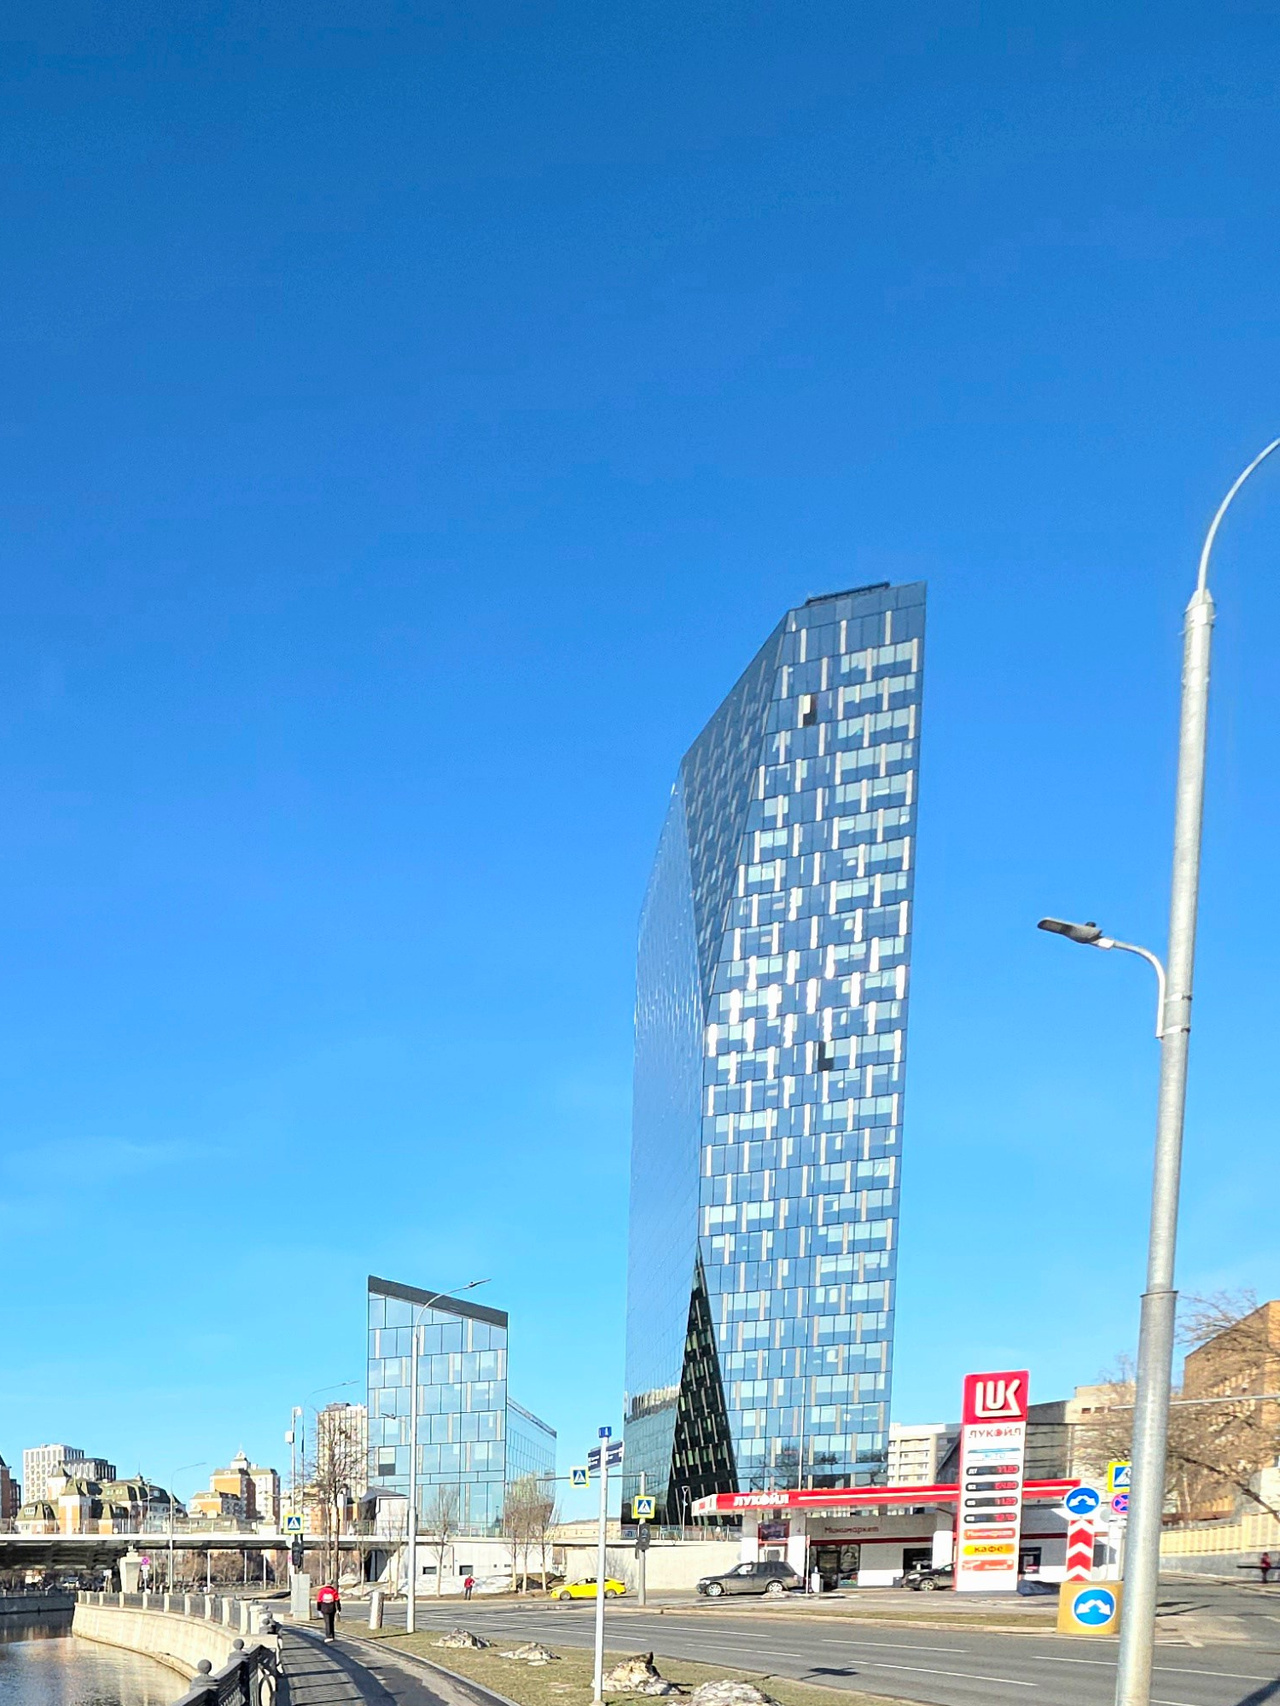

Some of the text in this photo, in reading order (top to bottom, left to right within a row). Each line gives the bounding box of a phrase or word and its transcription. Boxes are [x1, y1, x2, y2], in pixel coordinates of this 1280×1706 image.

[975, 1379, 1022, 1418] LUK
[968, 1427, 1022, 1438] ЛУКОЙЛ
[733, 1492, 790, 1507] ЛУКОЙЛ
[974, 1545, 1004, 1553] кафе
